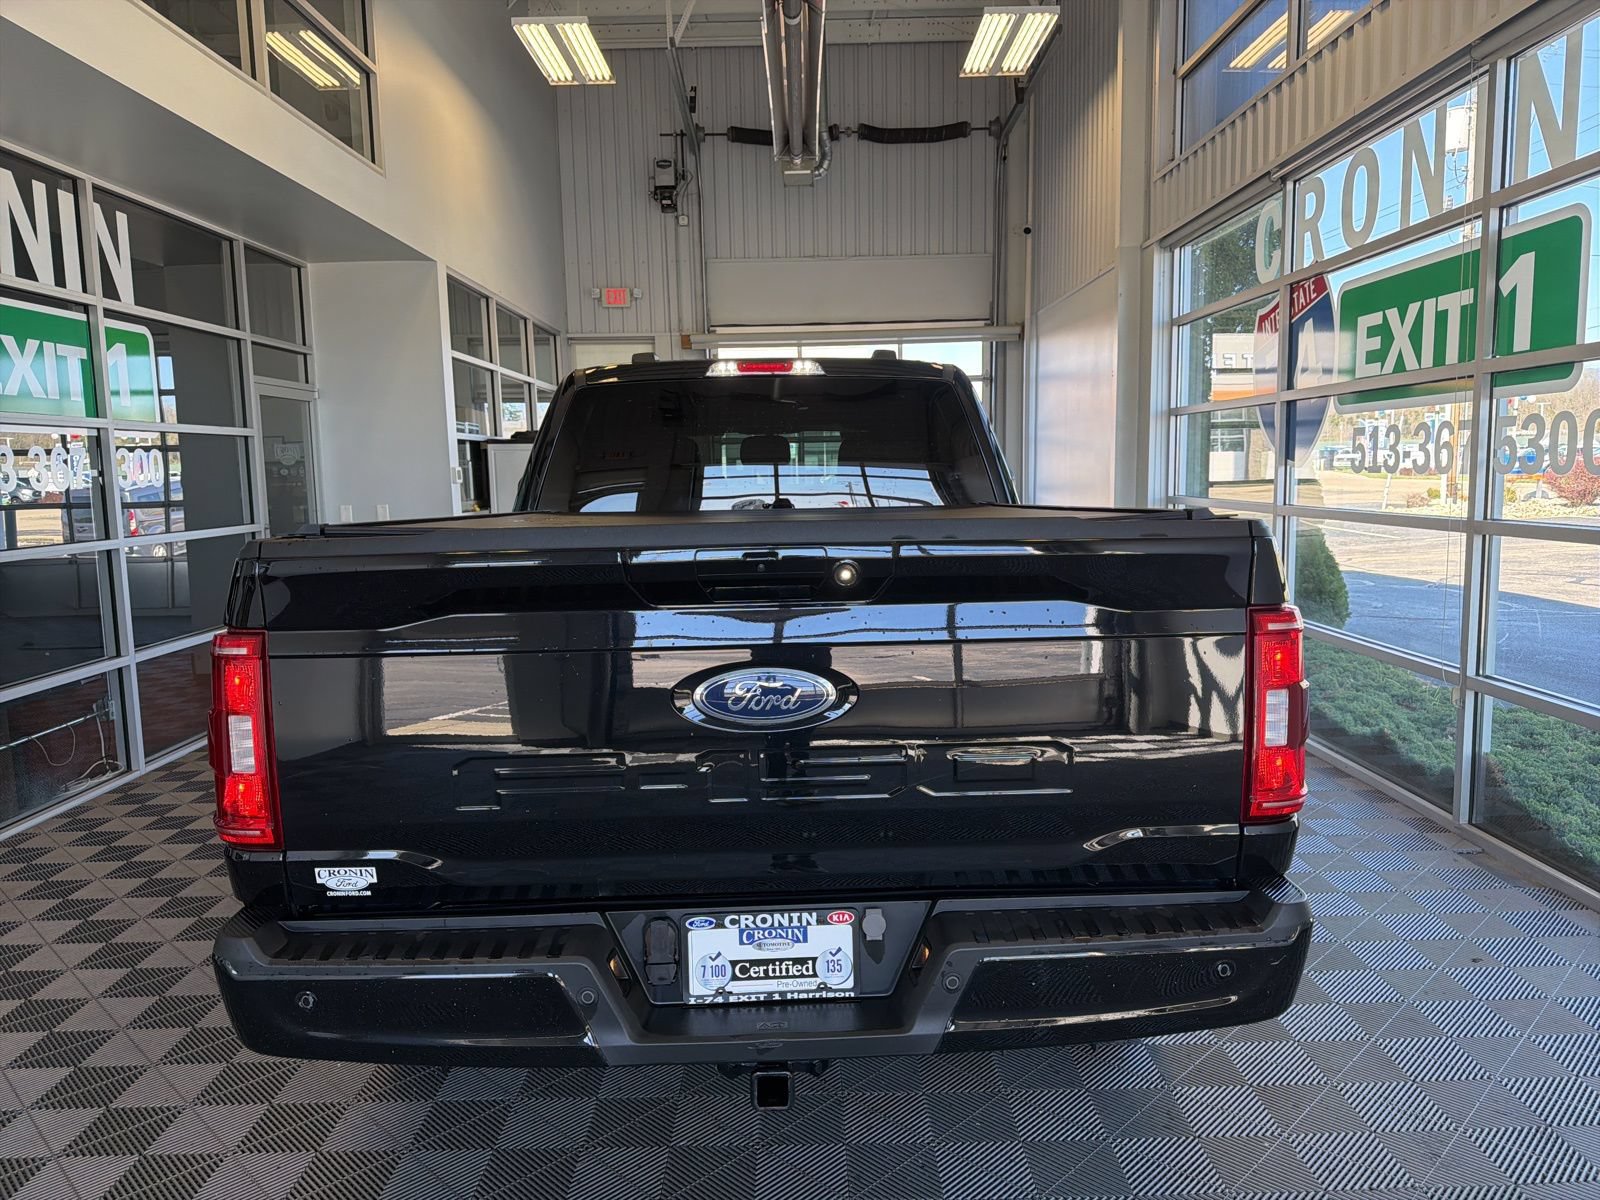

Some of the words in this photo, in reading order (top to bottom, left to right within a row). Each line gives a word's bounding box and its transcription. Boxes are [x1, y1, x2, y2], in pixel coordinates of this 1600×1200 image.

[1255, 24, 1586, 284] CRONIN
[606, 288, 627, 304] EXIT
[1355, 287, 1475, 378] EXIT
[1498, 251, 1536, 353] 1
[0, 333, 88, 401] XIT
[107, 342, 132, 407] 1
[728, 680, 801, 711] Ford
[317, 868, 375, 880] CRONIN
[335, 878, 359, 888] Ford
[724, 912, 818, 929] CRONIN
[832, 913, 851, 922] KIA
[742, 928, 804, 944] CRONIN
[734, 959, 814, 978] Certified
[825, 958, 843, 974] 135
[776, 979, 818, 989] Pre-Owned
[688, 996, 724, 1005] I-74
[728, 993, 768, 1003] EXIT
[786, 991, 855, 1000] Harrison
